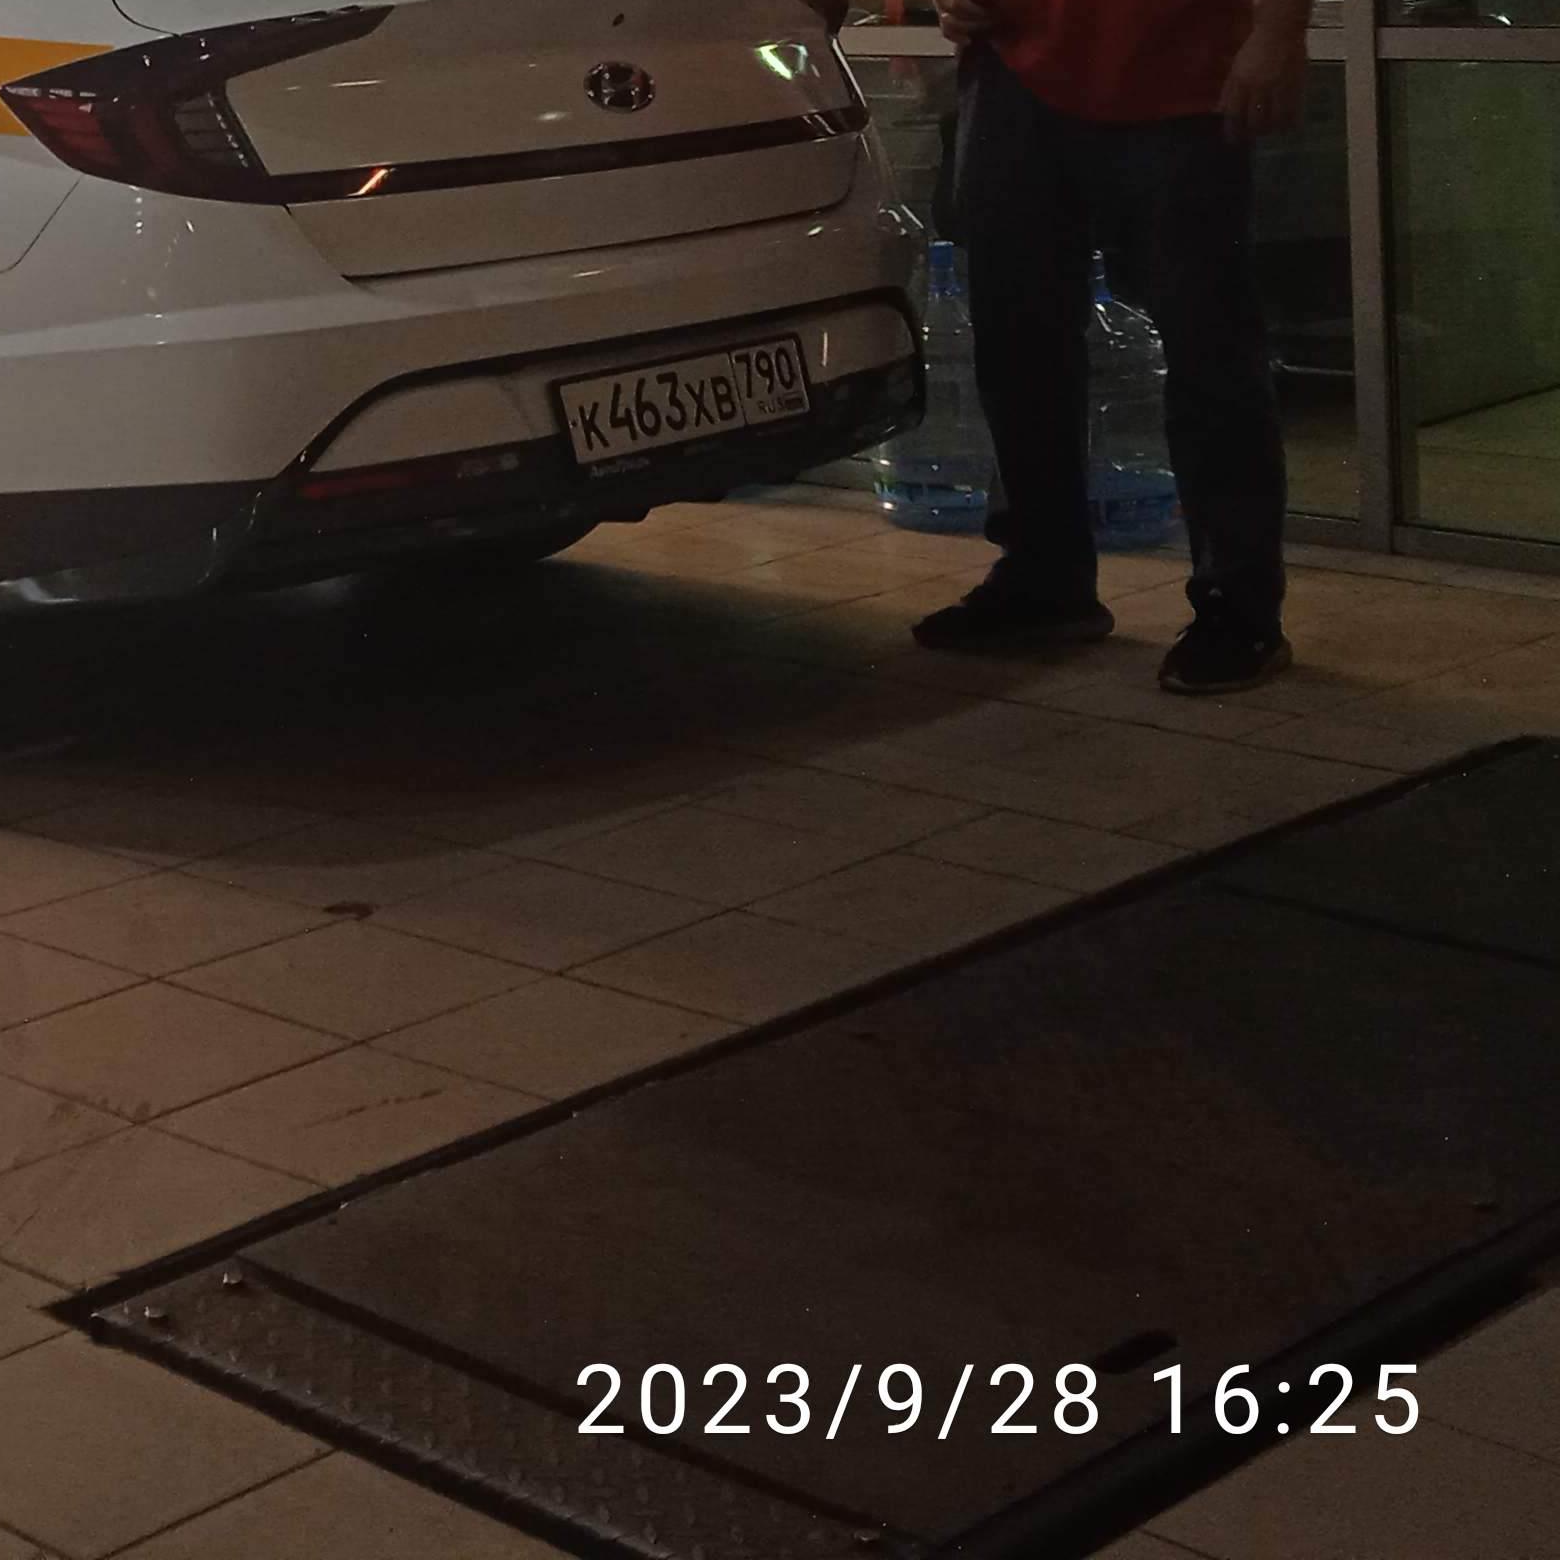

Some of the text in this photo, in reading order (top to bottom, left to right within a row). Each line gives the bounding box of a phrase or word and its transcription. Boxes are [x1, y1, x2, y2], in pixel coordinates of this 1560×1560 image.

[735, 346, 794, 399] 790
[577, 371, 737, 452] К463ХВ
[757, 399, 785, 415] RUS
